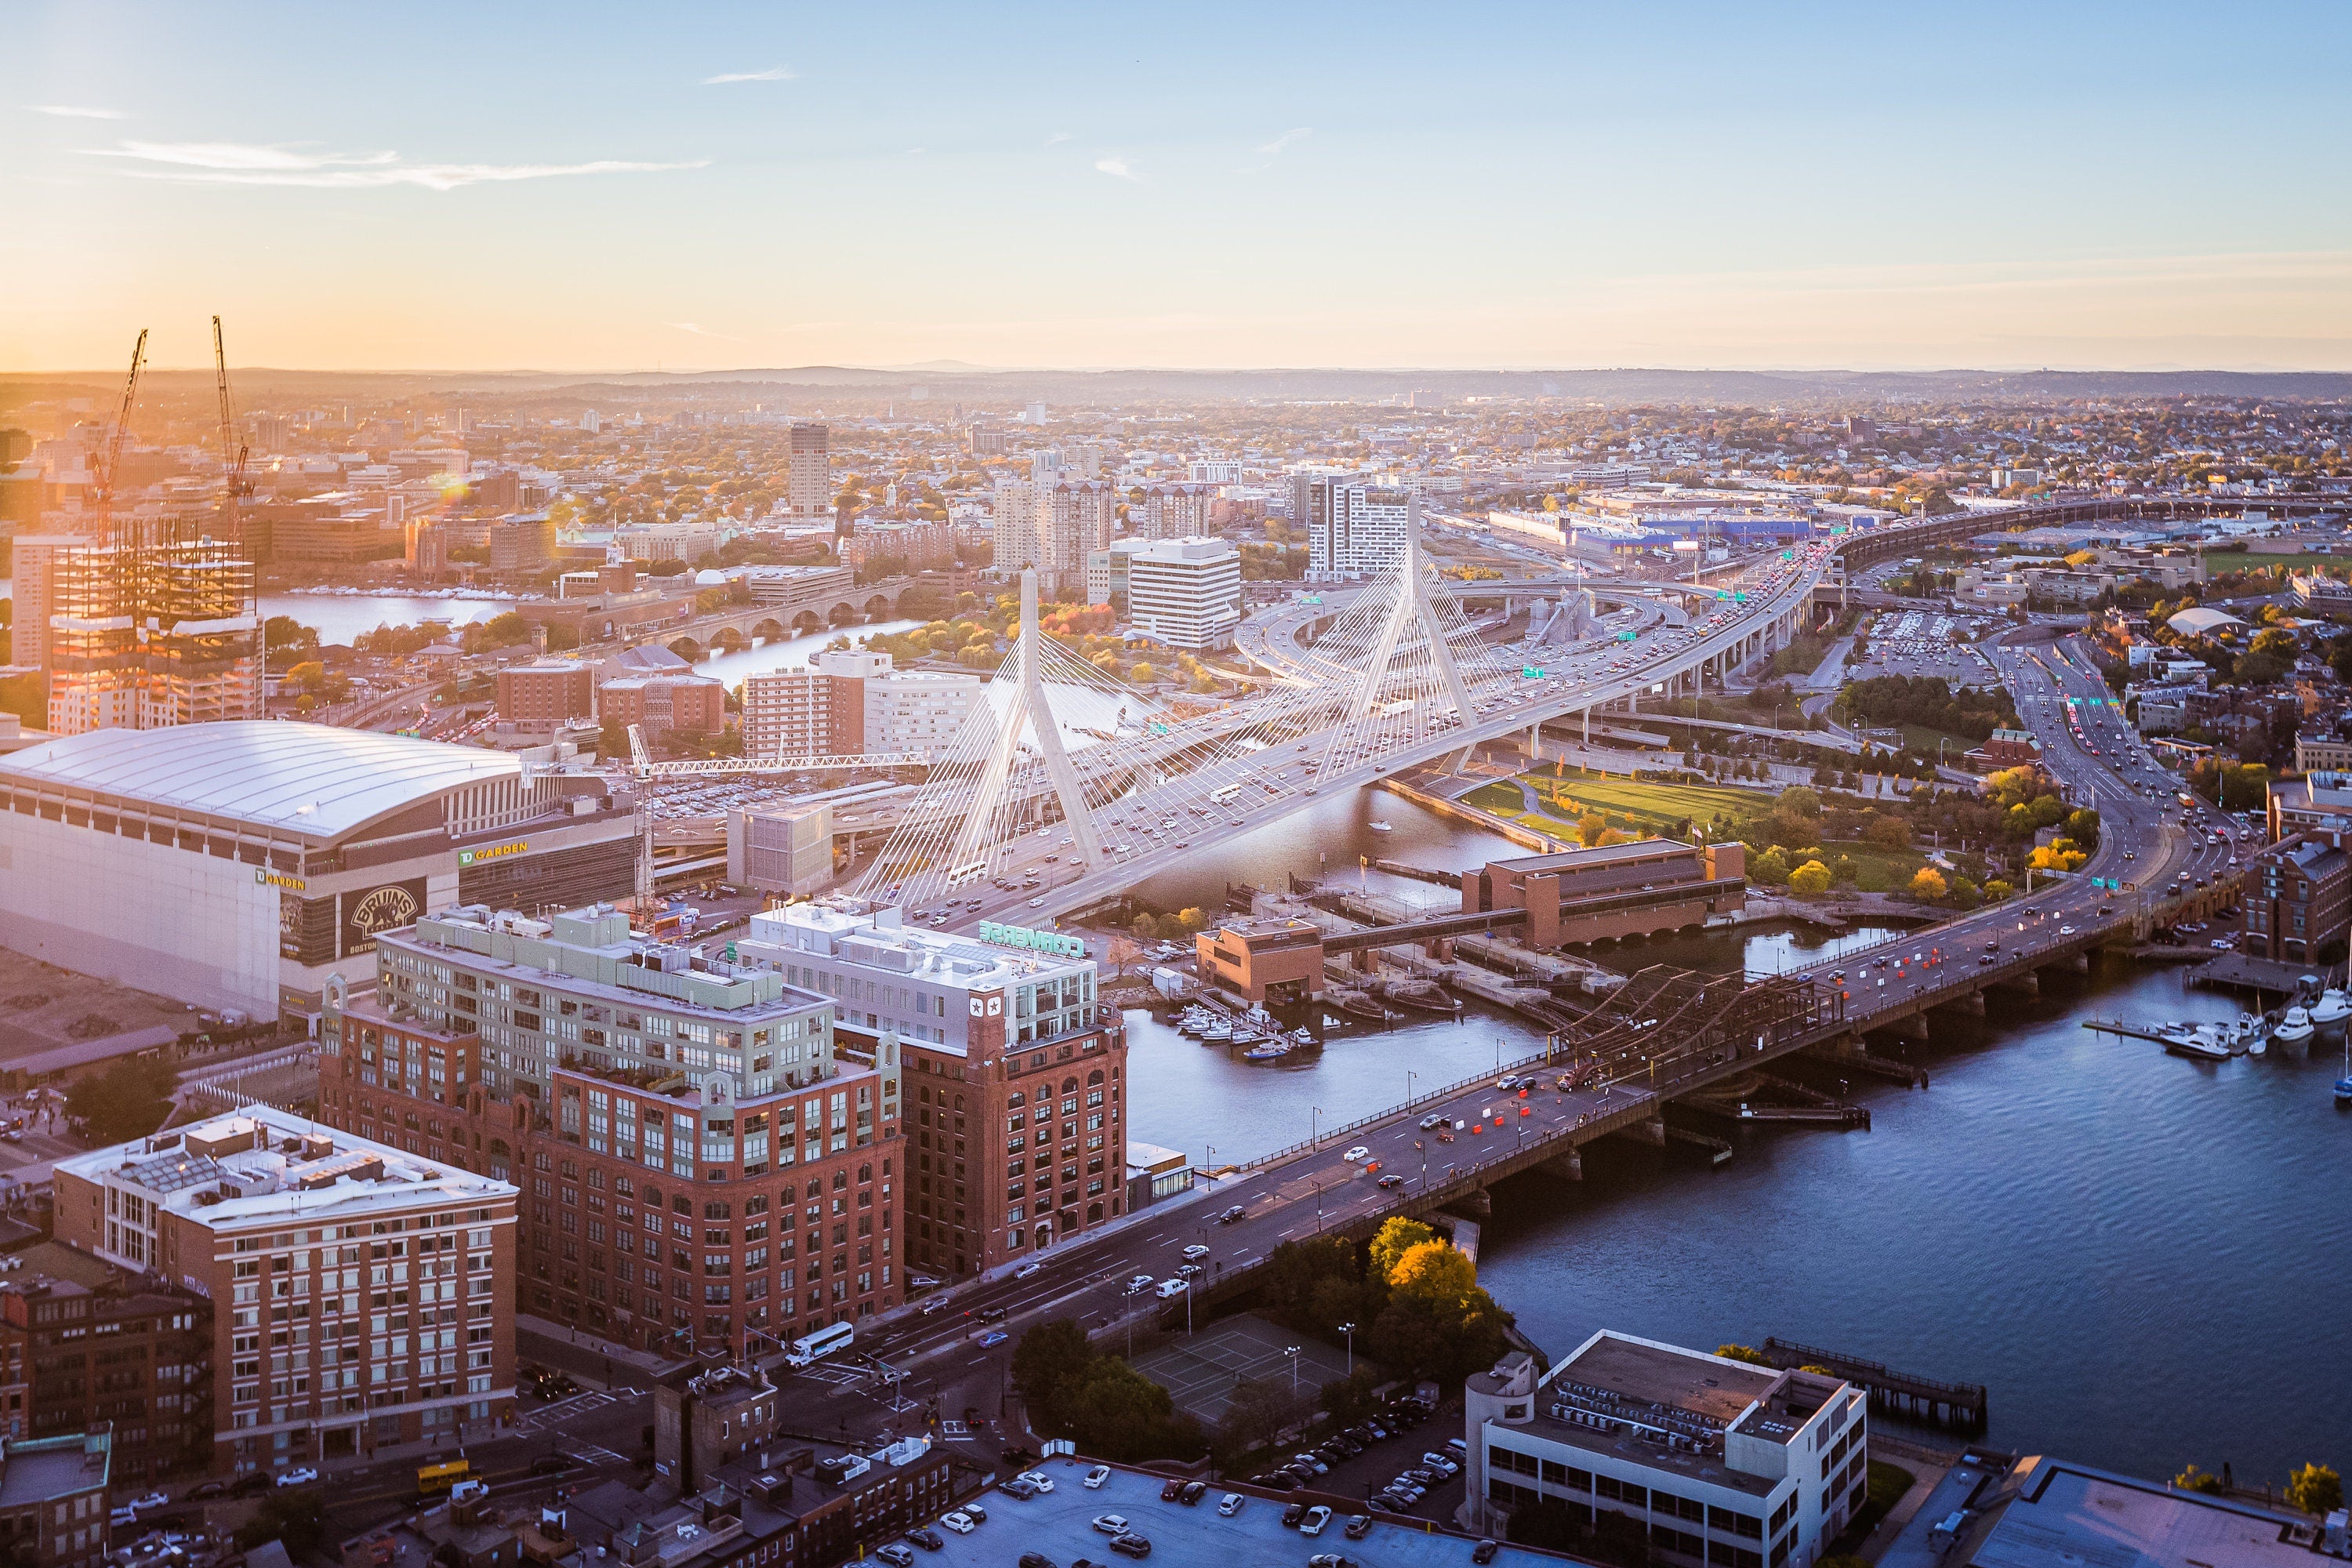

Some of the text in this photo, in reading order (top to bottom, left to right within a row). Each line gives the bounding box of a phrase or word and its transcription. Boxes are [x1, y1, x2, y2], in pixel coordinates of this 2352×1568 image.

[461, 842, 528, 863] TD GARDEN
[266, 874, 305, 891] GARDEN
[357, 891, 412, 924] BRUINS
[350, 942, 377, 954] BOSTON
